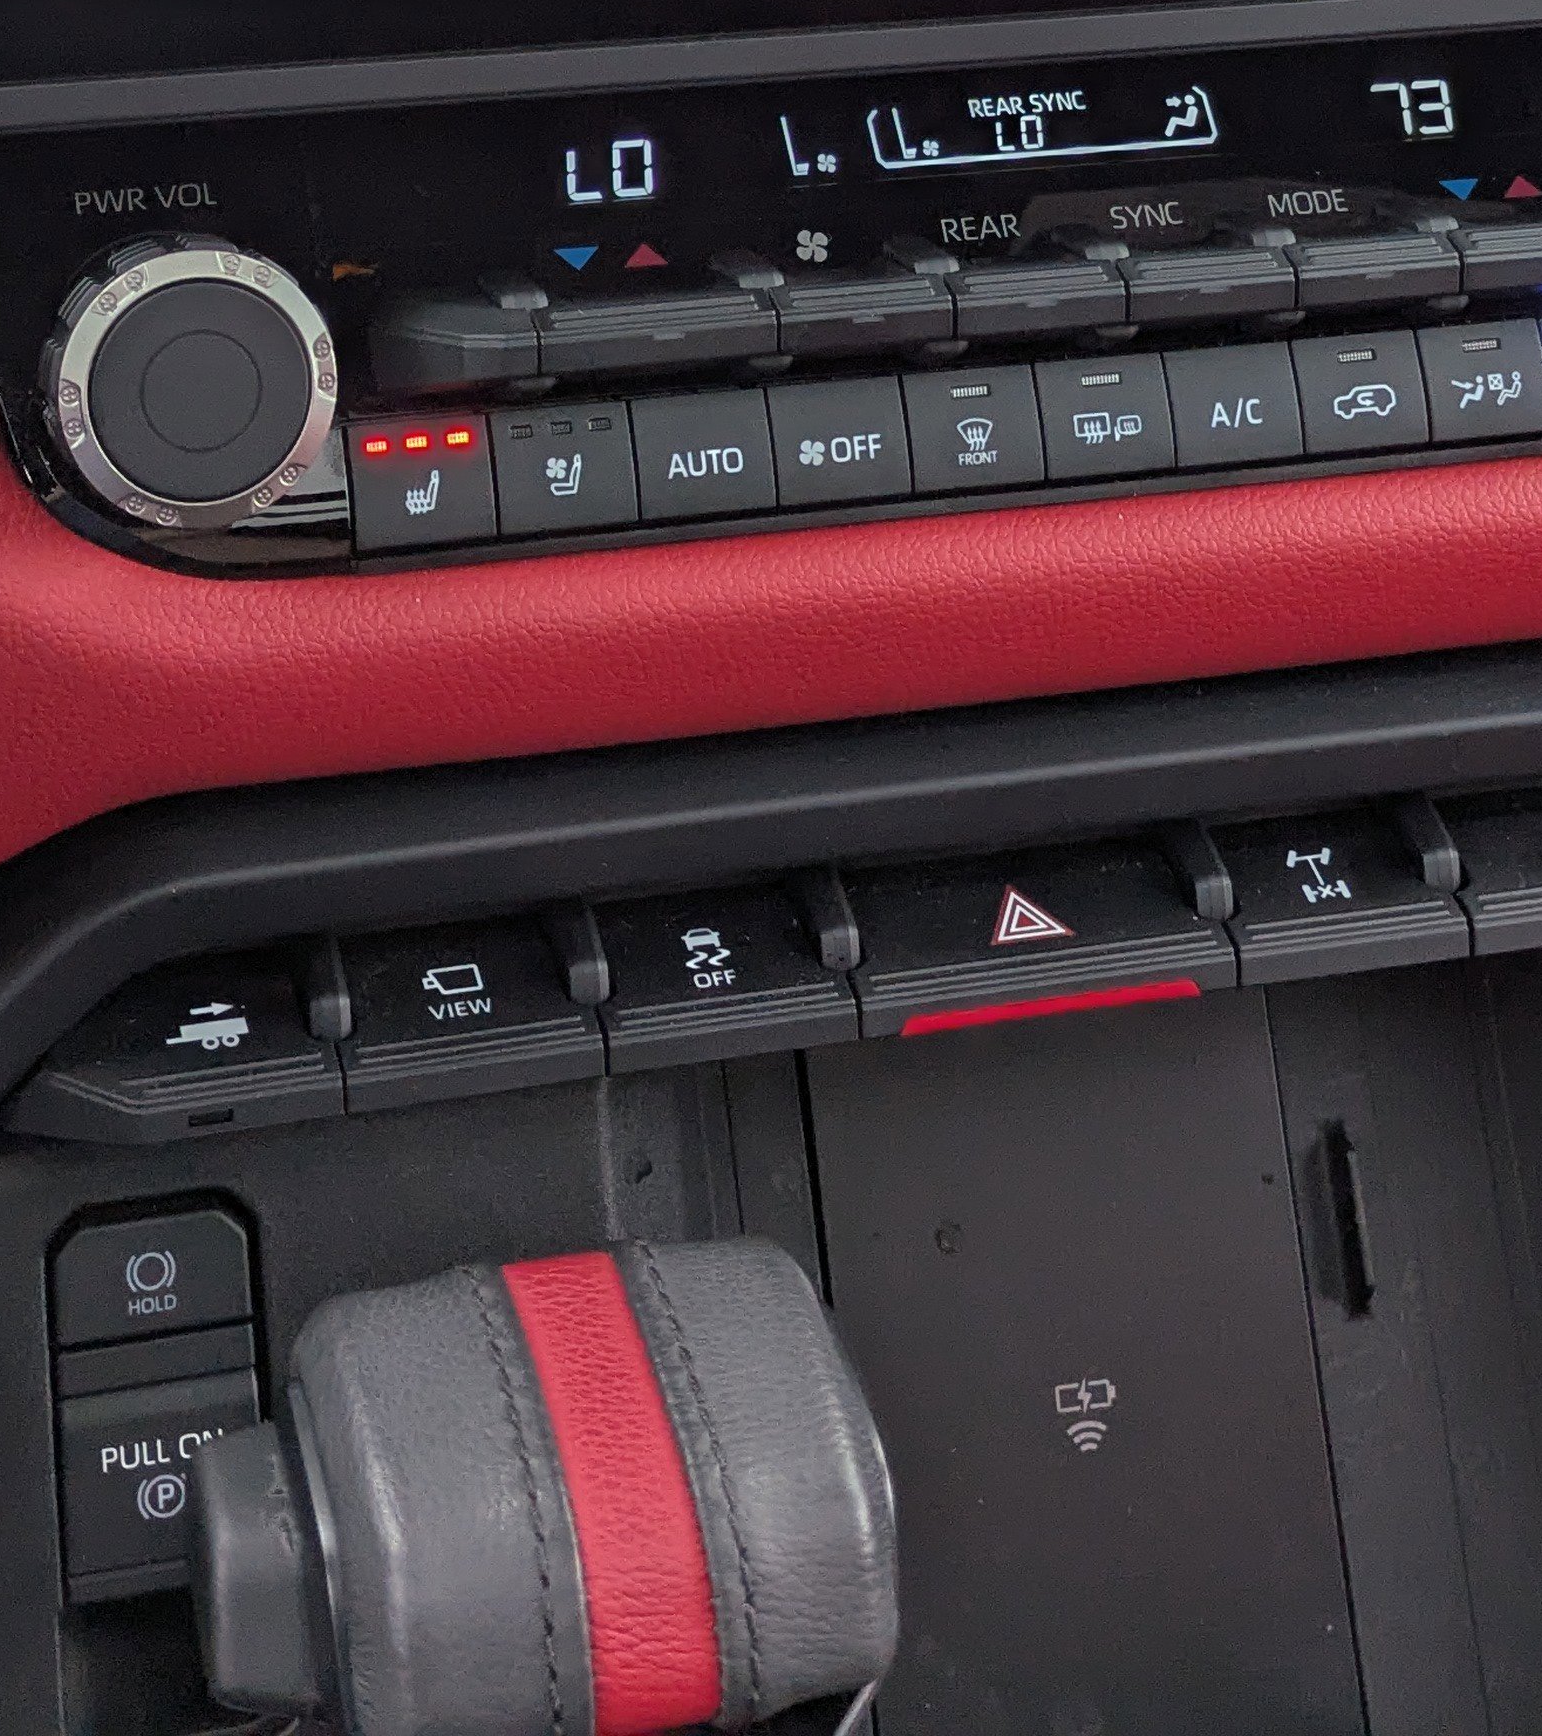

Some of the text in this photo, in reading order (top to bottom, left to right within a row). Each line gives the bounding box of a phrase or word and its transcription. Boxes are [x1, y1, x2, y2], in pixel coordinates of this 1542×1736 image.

[967, 91, 1086, 118] REAR SYNC
[1370, 79, 1453, 135] 73
[996, 115, 1047, 152] LO
[566, 138, 654, 204] LO
[75, 183, 217, 214] PWR VOL
[1268, 188, 1348, 217] MODE
[941, 213, 1021, 243] REAR
[1110, 202, 1183, 229] SYNC
[1211, 398, 1262, 427] A/C
[831, 434, 881, 462] OFF
[958, 449, 997, 465] FRONT
[669, 448, 743, 479] AUTO
[694, 969, 735, 988] OFF
[428, 997, 490, 1020] VIEW
[128, 1295, 177, 1315] HOLD
[101, 1428, 223, 1473] PULL O
